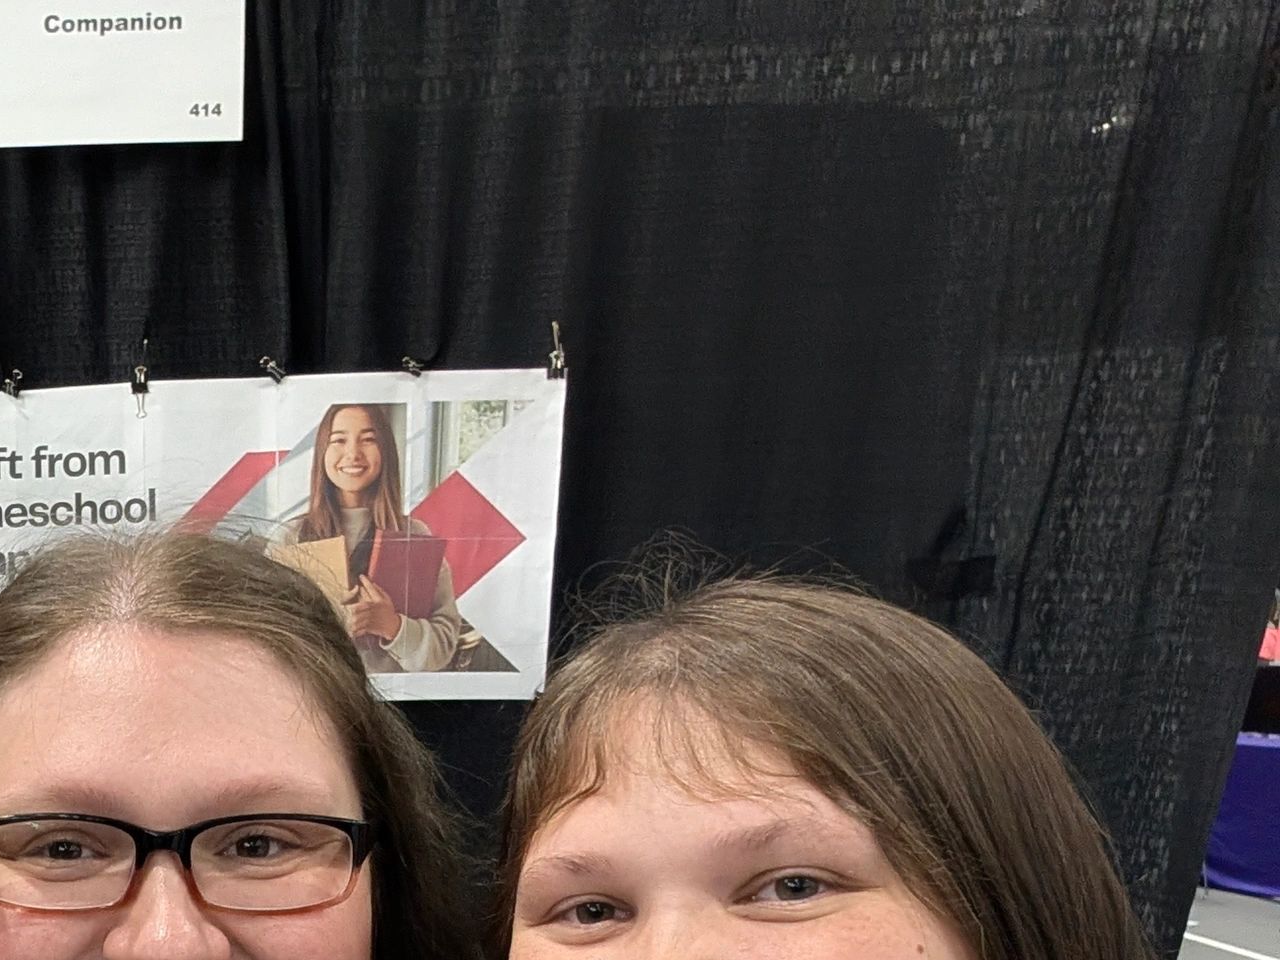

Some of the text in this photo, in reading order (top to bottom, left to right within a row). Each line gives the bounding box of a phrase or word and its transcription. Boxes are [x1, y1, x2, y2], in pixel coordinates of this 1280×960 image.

[44, 12, 183, 36] Companion
[189, 103, 222, 117] 414
[31, 445, 126, 478] from
